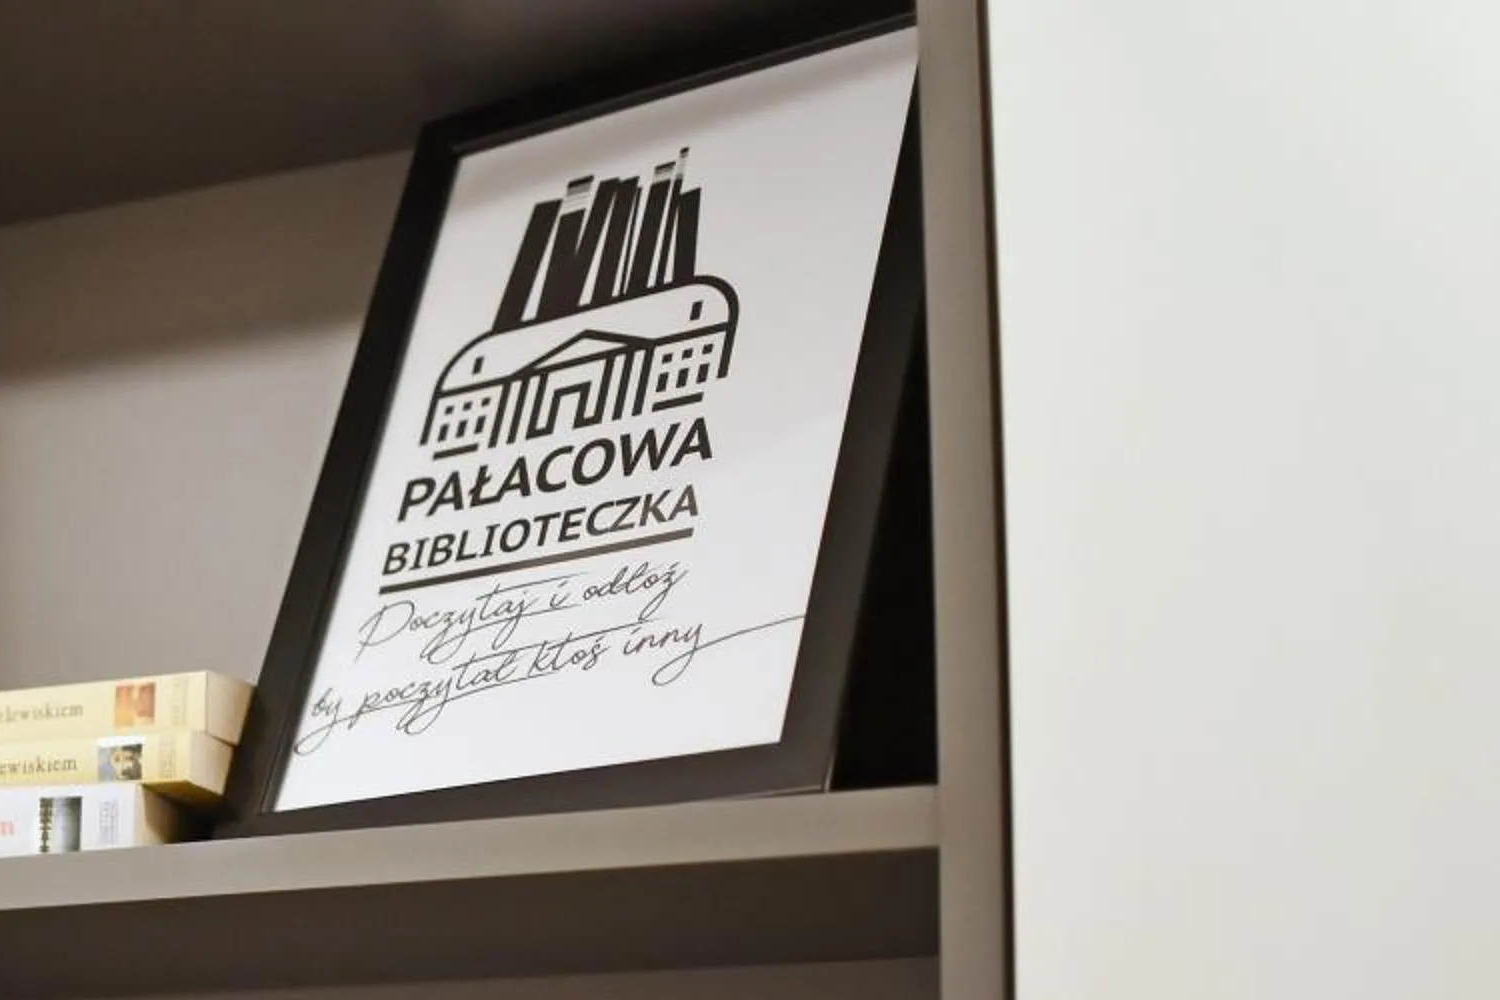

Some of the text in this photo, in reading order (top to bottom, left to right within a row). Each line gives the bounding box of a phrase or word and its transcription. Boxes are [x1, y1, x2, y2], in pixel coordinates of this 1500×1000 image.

[397, 417, 713, 522] PAŁACOWA
[382, 484, 699, 577] BIBLIOTECZKA
[355, 576, 552, 665] Poczytaj
[294, 687, 346, 756] by
[622, 623, 762, 686] inny
